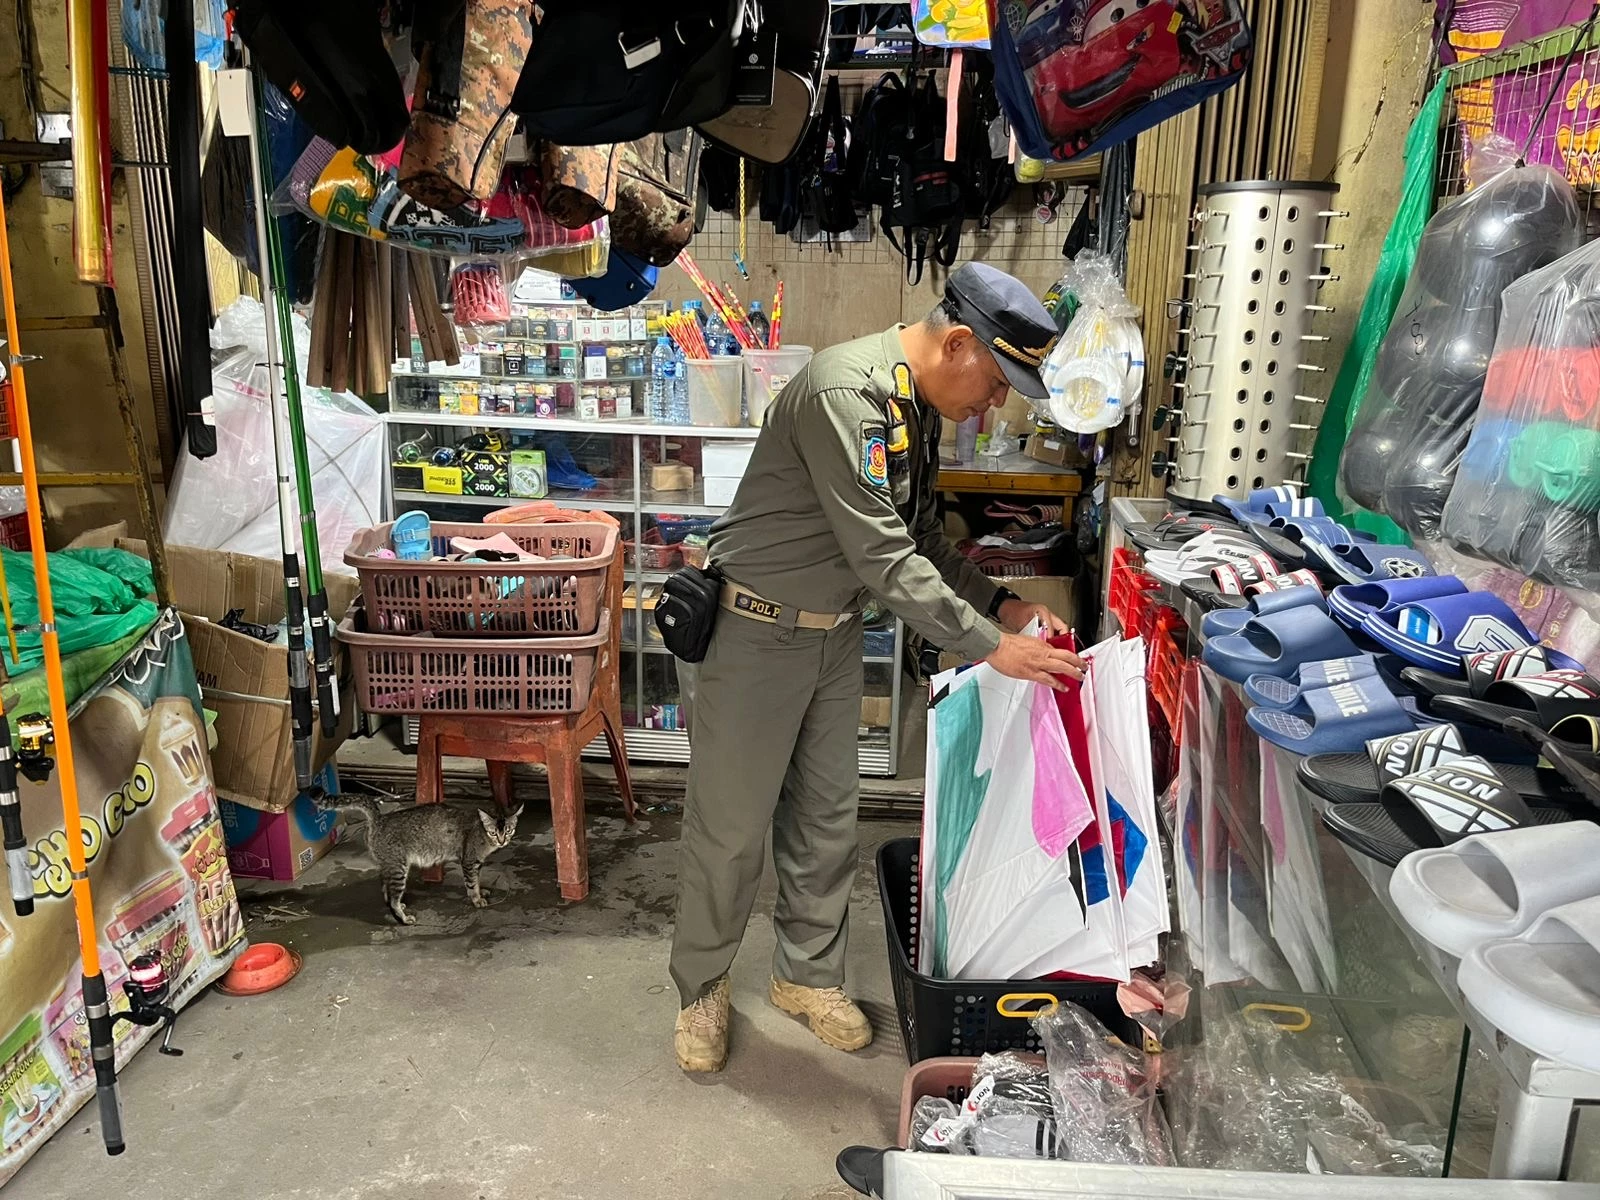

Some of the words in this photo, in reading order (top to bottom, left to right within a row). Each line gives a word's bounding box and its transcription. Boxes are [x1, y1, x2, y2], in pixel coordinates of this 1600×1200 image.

[474, 463, 494, 471] 2000
[475, 483, 496, 492] 2000
[749, 600, 771, 615] POL
[772, 607, 781, 617] P
[196, 670, 217, 689] AM
[1323, 658, 1351, 684] MILE
[1418, 769, 1501, 801] LION
